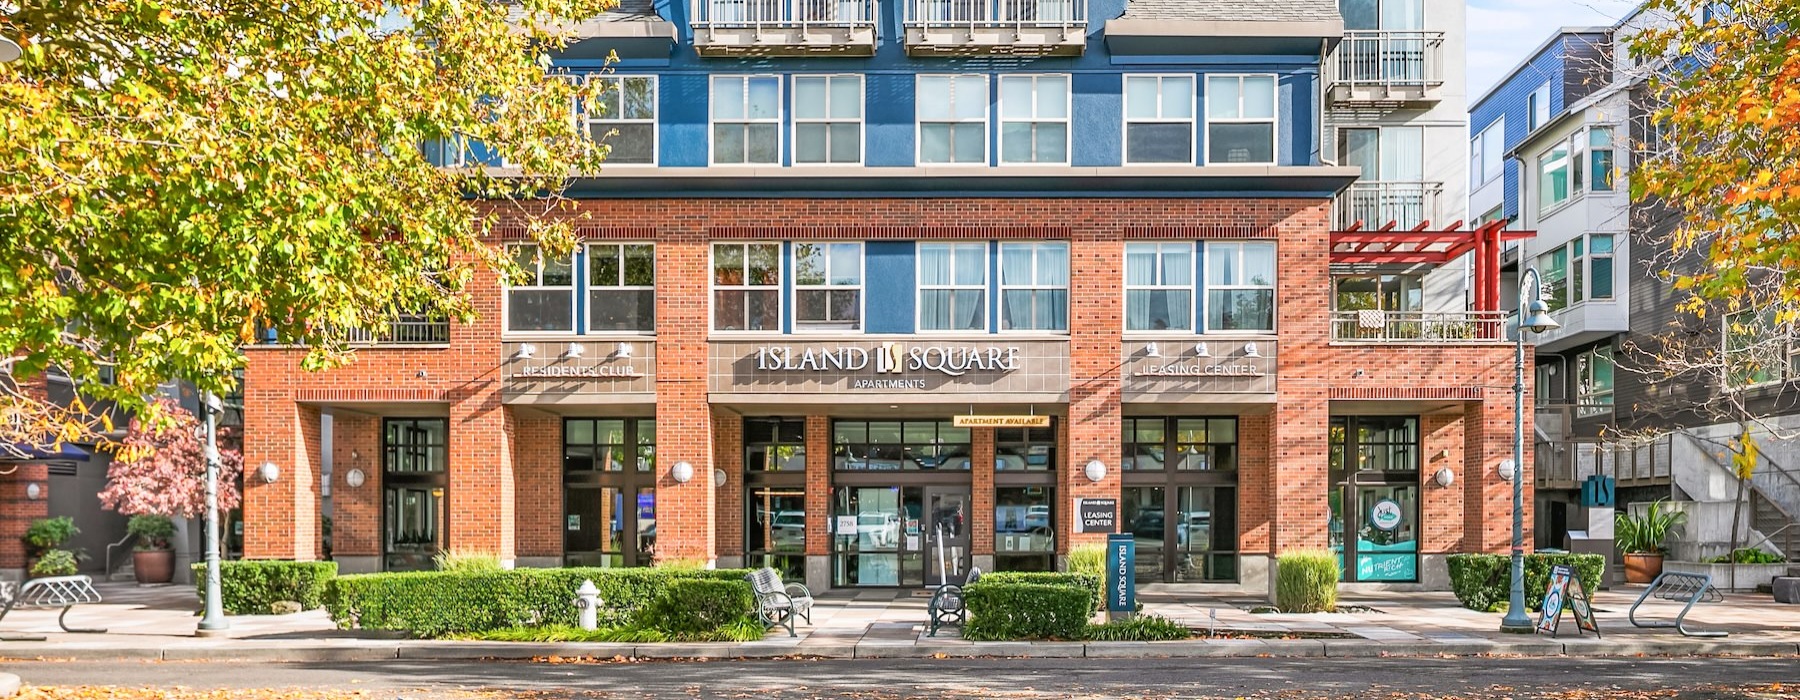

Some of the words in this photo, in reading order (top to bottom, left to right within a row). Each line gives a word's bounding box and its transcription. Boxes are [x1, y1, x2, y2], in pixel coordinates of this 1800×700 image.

[758, 346, 869, 371] ISLAND
[909, 346, 1021, 376] SQUARE
[523, 365, 595, 376] RESIDENTS
[599, 365, 635, 376] CLUB
[1142, 365, 1199, 375] LEASING
[1204, 365, 1257, 375] CENTER
[854, 379, 926, 389] APARTMENTS
[1084, 511, 1113, 519] LEASING
[1119, 545, 1127, 575] ISLAND
[1118, 576, 1127, 606] SQUARE
